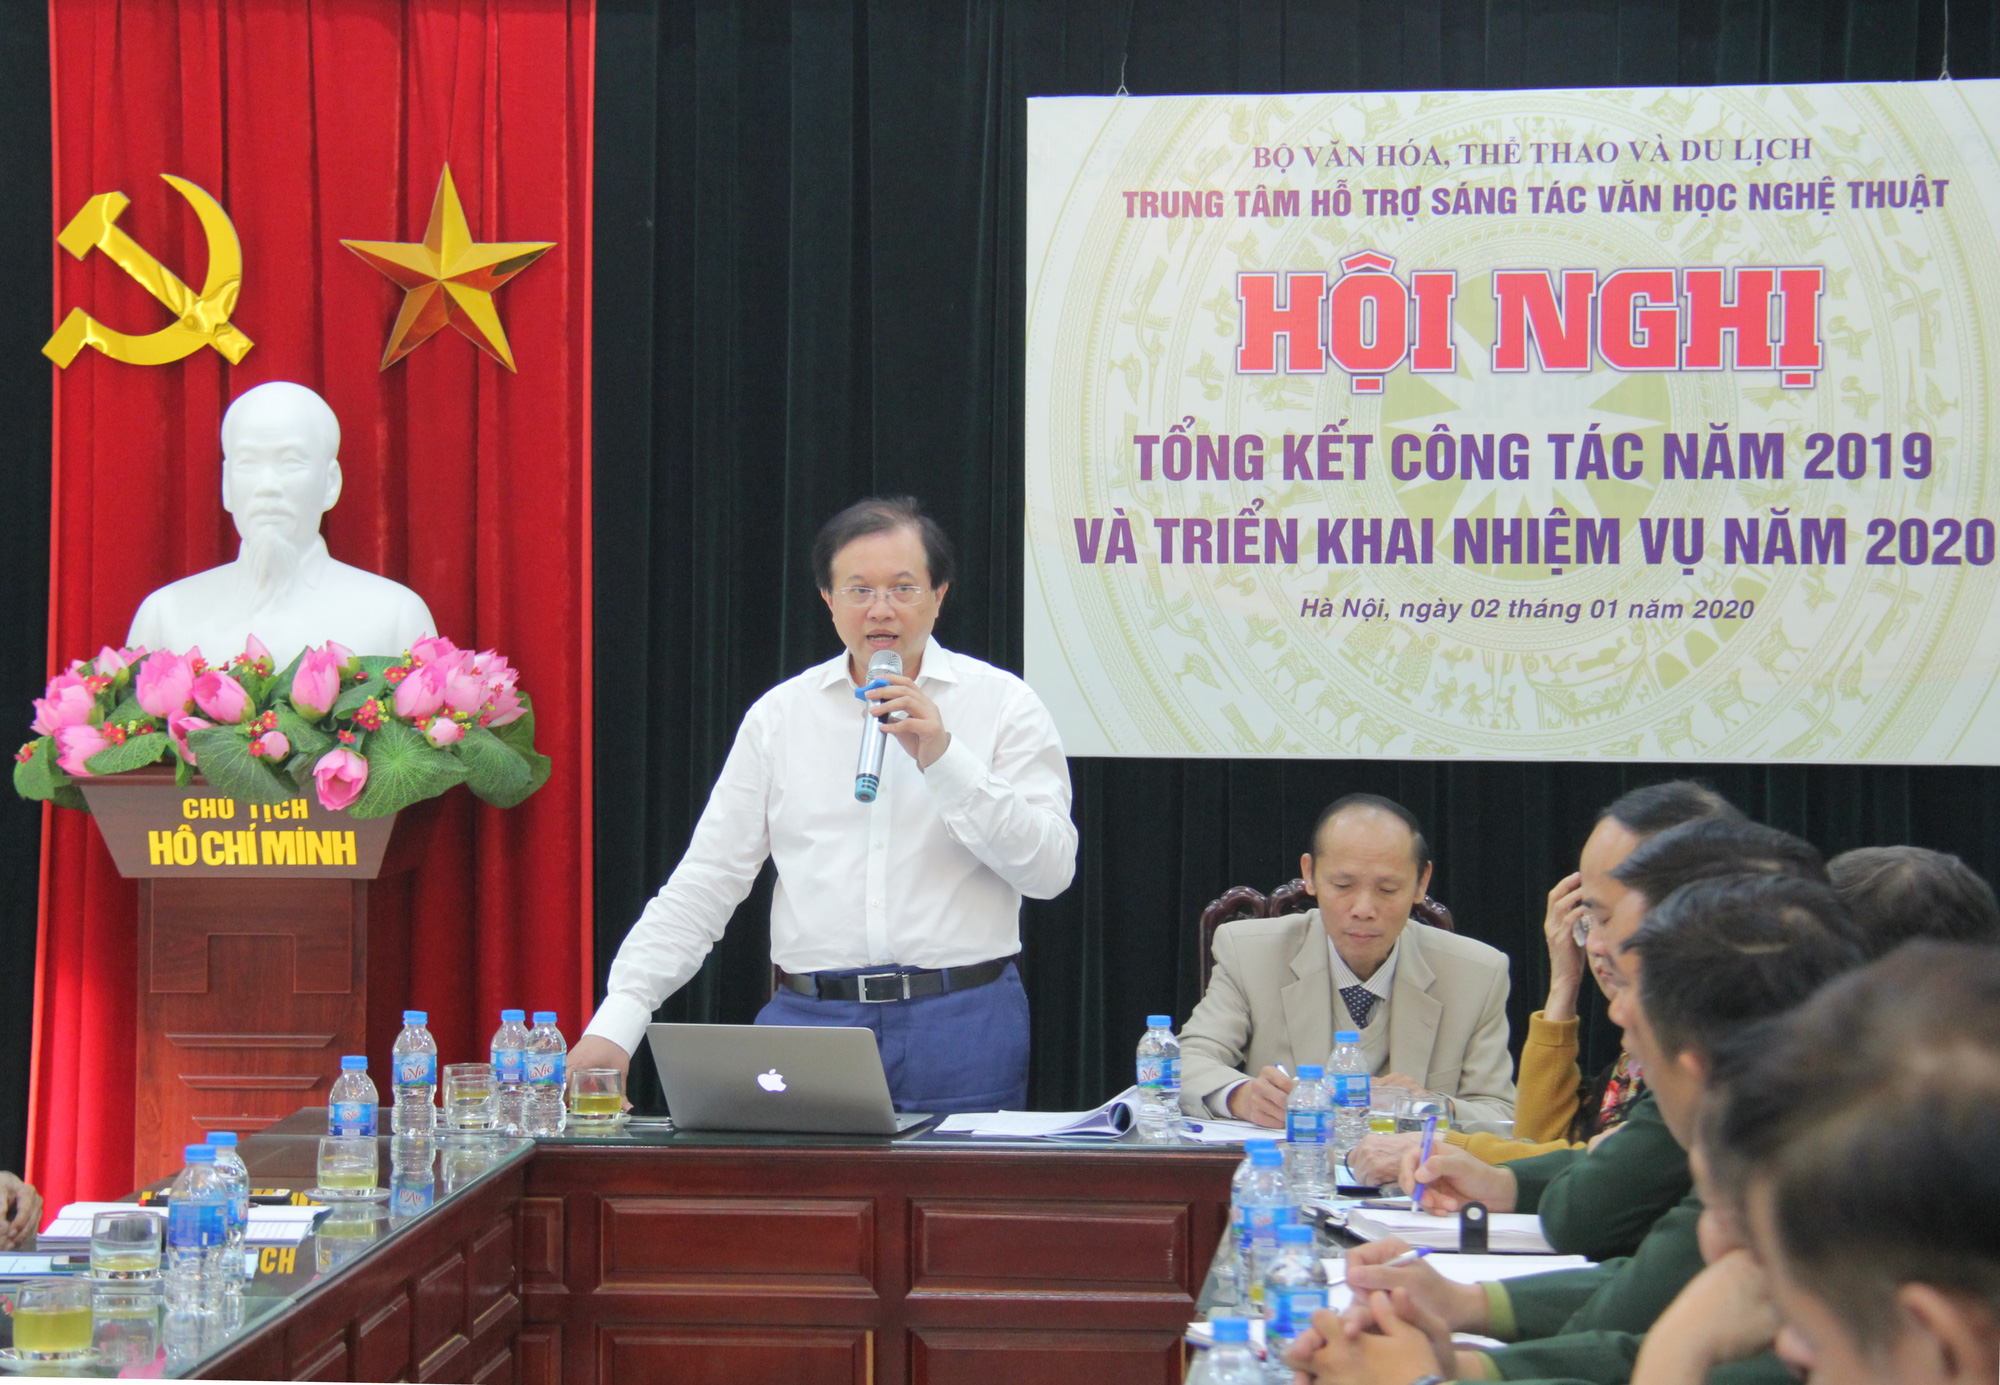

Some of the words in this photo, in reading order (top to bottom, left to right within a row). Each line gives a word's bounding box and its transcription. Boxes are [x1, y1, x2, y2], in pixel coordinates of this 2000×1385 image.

[1254, 142, 1295, 174] BỘ
[1303, 140, 1367, 168] VĂN
[1377, 138, 1450, 170] HÓA,
[1459, 135, 1521, 166] THỂ
[1529, 141, 1619, 165] THAO
[1630, 133, 1671, 163] VÀ
[1681, 139, 1724, 163] DU
[1735, 138, 1812, 166] LỊCH
[1123, 189, 1224, 218] TRUNG
[1234, 184, 1300, 218] TÂM
[1311, 179, 1351, 217] HỖ
[1363, 186, 1422, 222] TRỢ
[1431, 181, 1517, 216] SÁNG
[1528, 180, 1587, 214] TÁC
[1598, 179, 1661, 213] VĂN
[1673, 183, 1737, 218] HỌC
[1749, 176, 1835, 216] NGHỆ
[1847, 174, 1949, 214] THUẬT
[1236, 249, 1457, 395] HỘI
[1491, 265, 1825, 389] NGHỊ
[1134, 415, 1264, 481] TỔNG
[1283, 419, 1373, 480] KẾT
[1391, 424, 1529, 481] CÔNG
[1547, 423, 1643, 481] TÁC
[1663, 422, 1785, 480] NĂM
[1804, 432, 1932, 480] 2019
[1074, 508, 1137, 564] VÀ
[1154, 498, 1298, 564] TRIỂN
[1317, 518, 1433, 564] KHAI
[1453, 507, 1620, 575] NHIỆM
[1639, 518, 1704, 576] VỤ
[1723, 507, 1847, 565] NĂM
[1866, 518, 1996, 566] 2020
[1300, 597, 1333, 618] Hà
[1342, 598, 1390, 622] Nội,
[1400, 598, 1462, 623] ngày
[1470, 599, 1500, 619] 02
[1508, 598, 1581, 624] tháng
[1590, 599, 1618, 619] 01
[1628, 598, 1683, 619] năm
[1692, 599, 1755, 620] 2020
[201, 822, 258, 866] CHÍ
